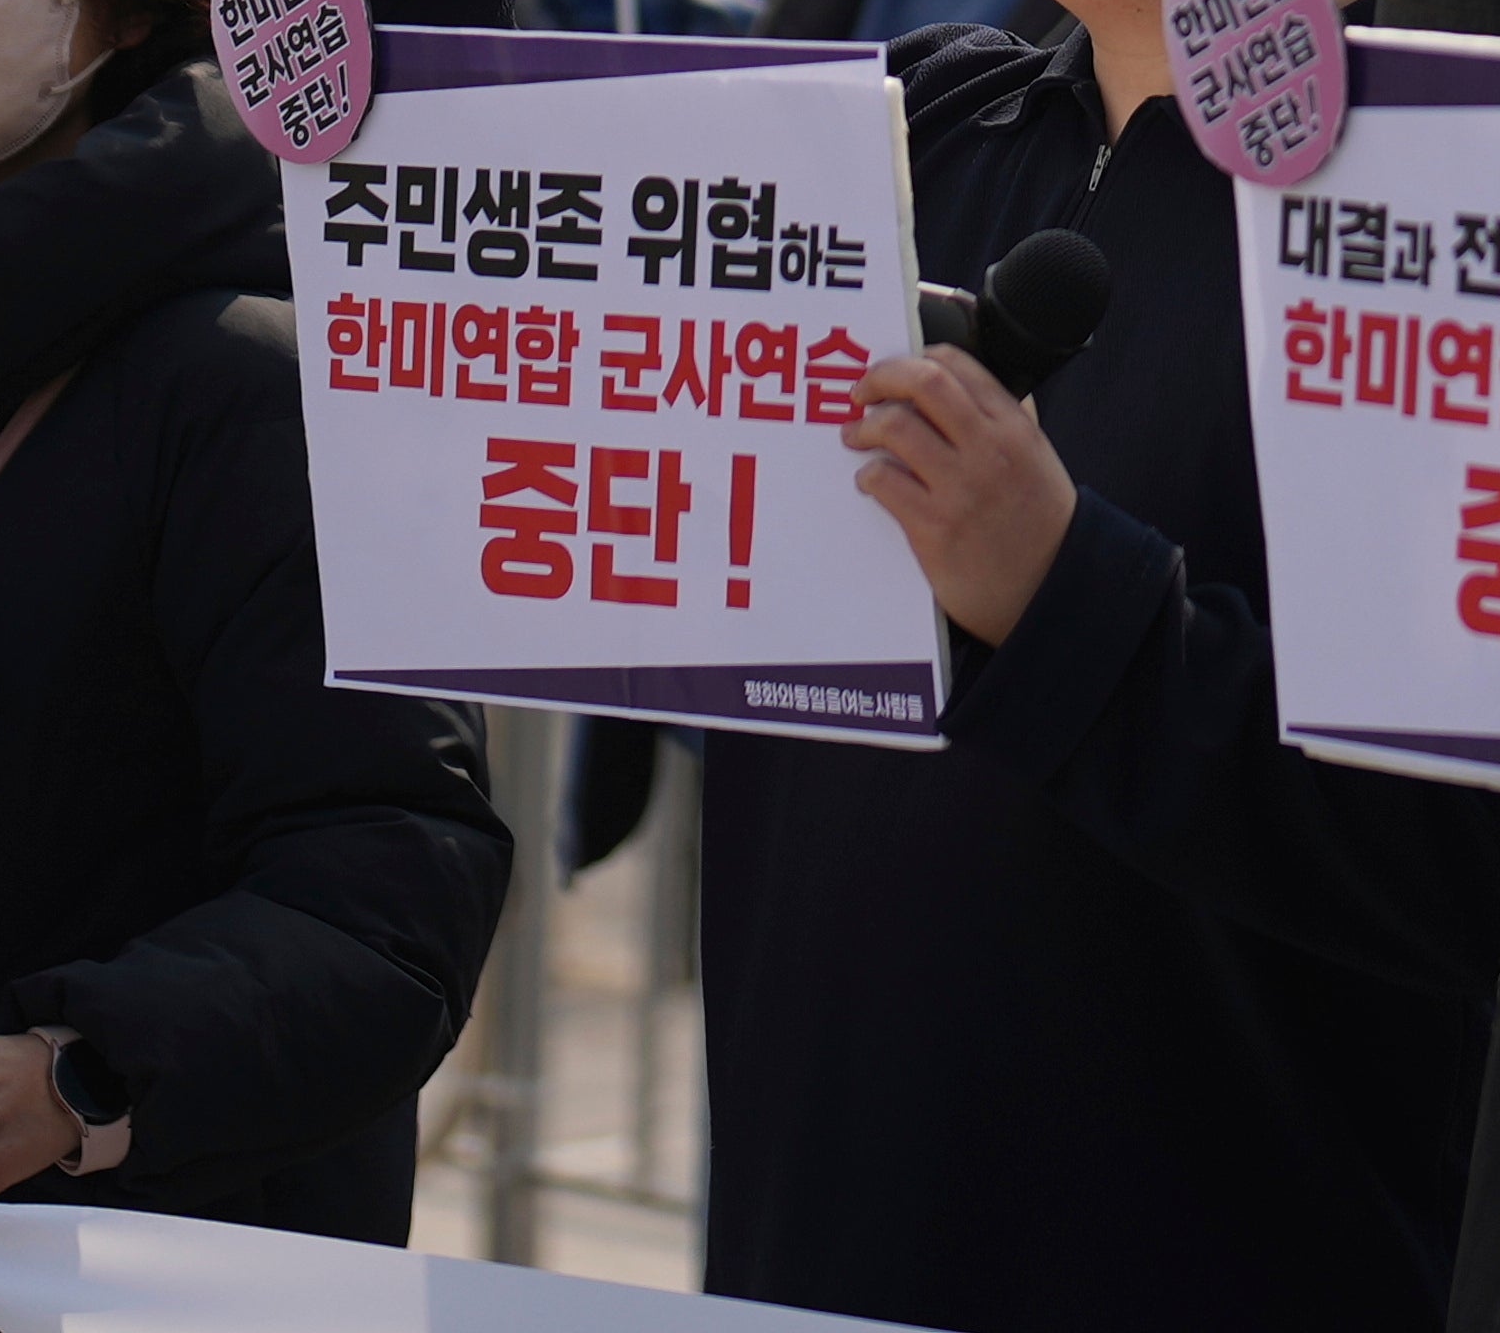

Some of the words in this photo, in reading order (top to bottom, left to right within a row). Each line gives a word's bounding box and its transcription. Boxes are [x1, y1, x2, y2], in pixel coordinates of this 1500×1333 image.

[234, 2, 350, 110] 군사연습
[1189, 12, 1318, 125] 군사연습
[323, 161, 603, 282] 주민생존
[627, 175, 866, 291] 위협하는
[1278, 194, 1437, 290] 대결과
[326, 293, 579, 409] 한미연합
[599, 311, 870, 425] 군사연습
